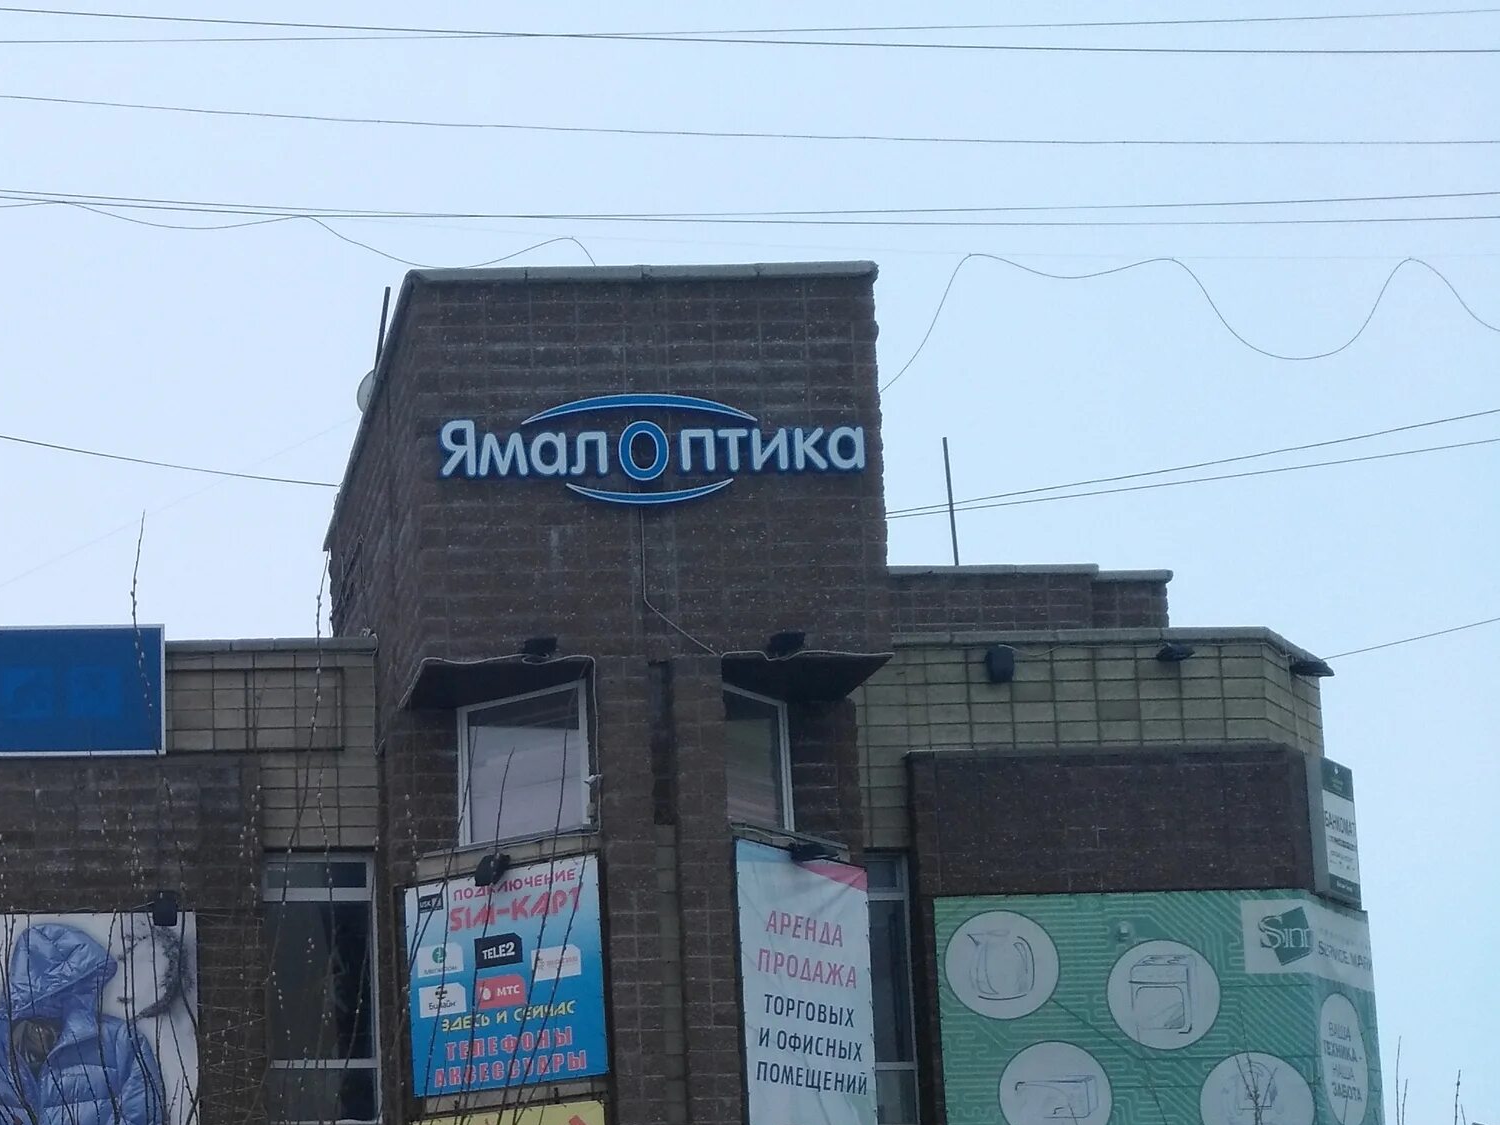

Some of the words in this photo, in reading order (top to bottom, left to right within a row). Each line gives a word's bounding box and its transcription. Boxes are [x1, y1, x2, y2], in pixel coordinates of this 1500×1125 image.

[766, 910, 843, 947] АРЕНДА
[482, 941, 515, 960] TELE2
[757, 948, 856, 989] ПРОДАЖА
[496, 983, 520, 997] МТС
[441, 1014, 490, 1032] ЗДЕСЬ
[496, 1010, 508, 1023] И
[513, 1000, 577, 1022] СЕЙЧАС
[764, 994, 855, 1028] ТОРГОВЫХ
[445, 1026, 573, 1061] ТЕЛЕФОНЫ
[758, 1027, 769, 1048] И
[777, 1030, 862, 1062] ОФИСНЫХ
[434, 1050, 587, 1088] АКСЕССУАРЫ
[756, 1061, 868, 1096] ПОМЕЩЕНИЙ
